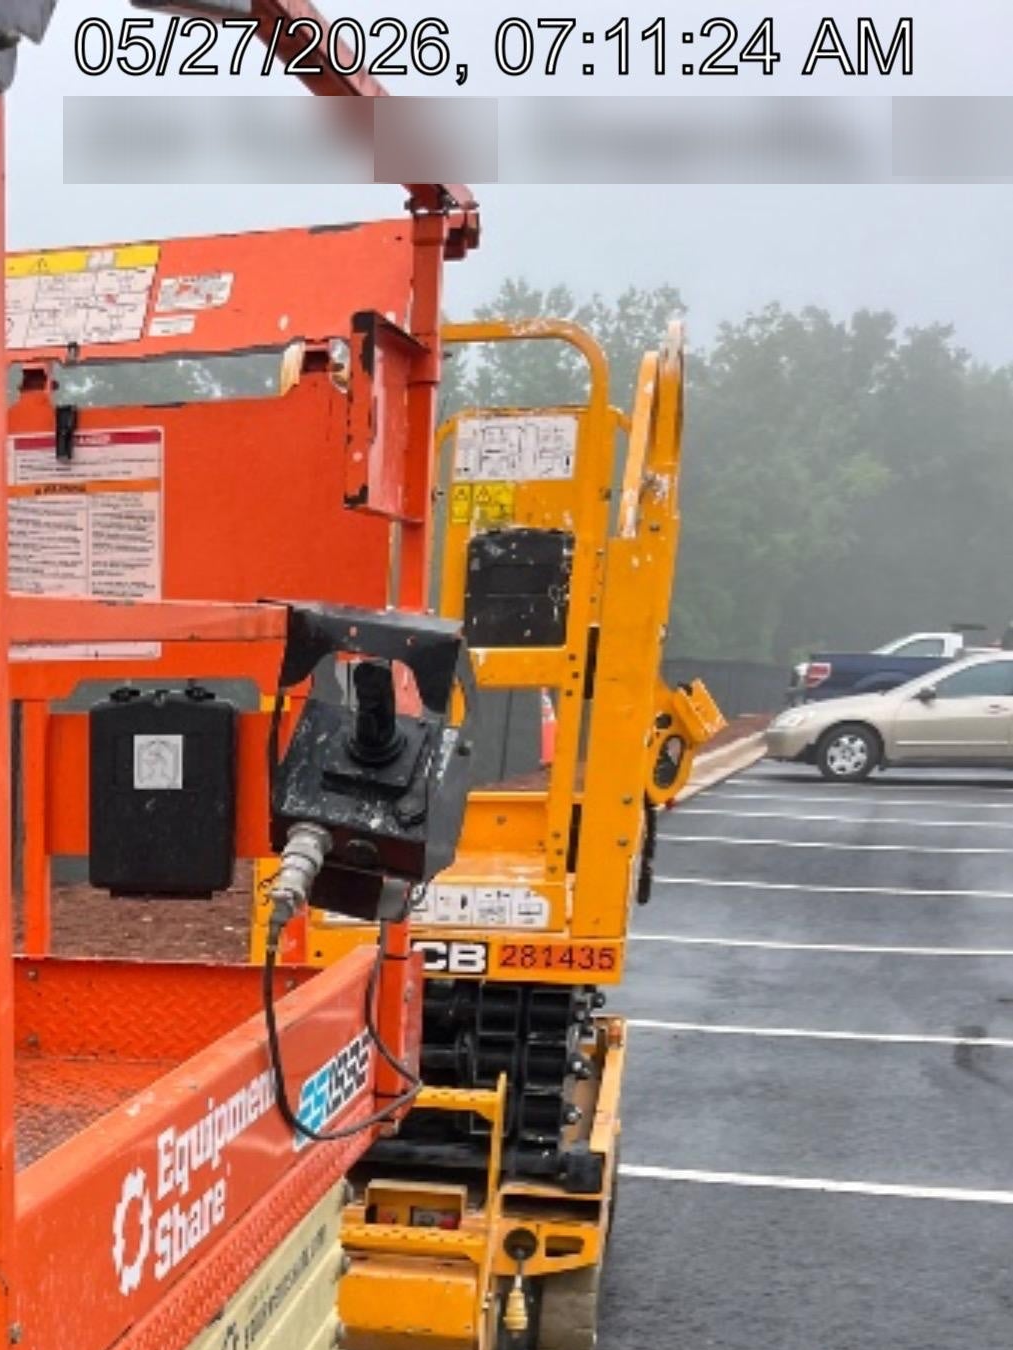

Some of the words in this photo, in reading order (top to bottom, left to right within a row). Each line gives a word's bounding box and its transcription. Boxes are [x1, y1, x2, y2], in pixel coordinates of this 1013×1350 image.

[412, 941, 487, 974] CB
[499, 944, 616, 970] 281435
[154, 1177, 227, 1281] Share
